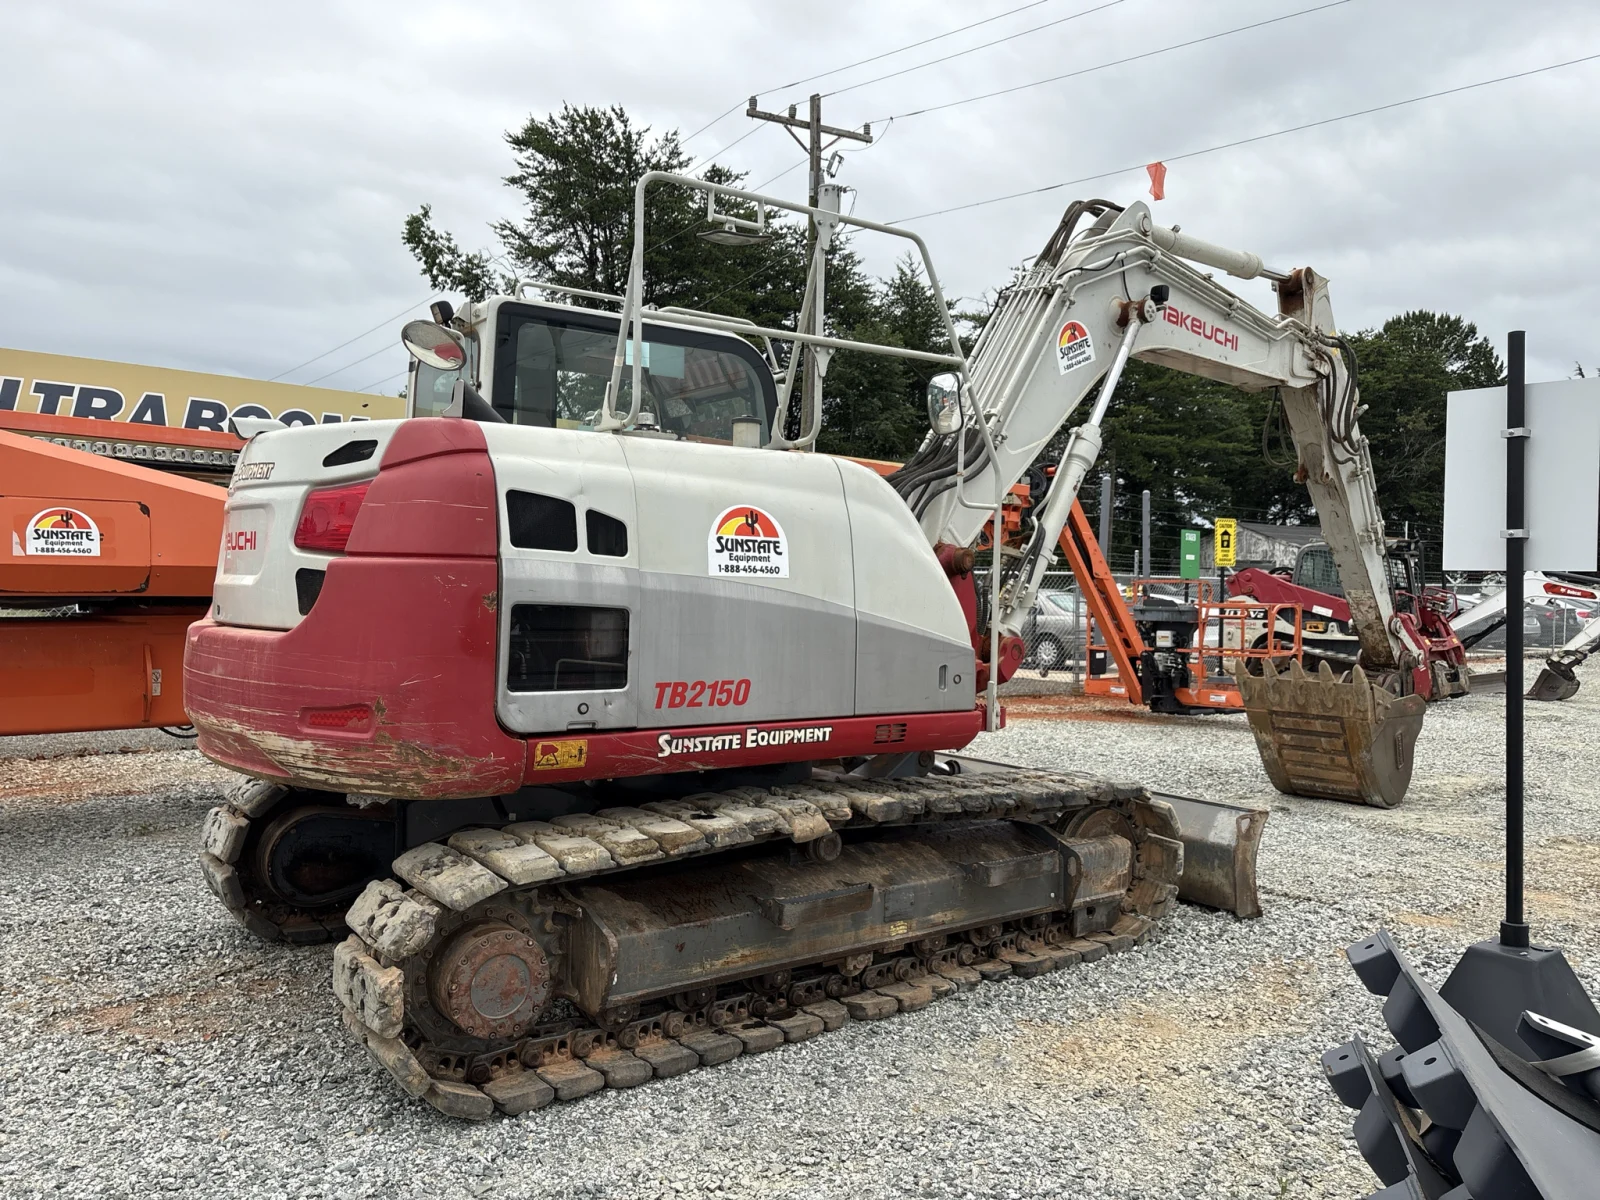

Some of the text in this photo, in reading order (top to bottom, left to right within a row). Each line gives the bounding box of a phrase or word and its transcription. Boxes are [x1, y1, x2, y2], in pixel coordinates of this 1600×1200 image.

[1060, 338, 1091, 360] SUNSTATE
[33, 528, 95, 542] SUNSTATE
[44, 539, 83, 547] Equipment
[715, 535, 783, 556] SUNSTATE
[728, 552, 771, 563] Equipment
[718, 564, 780, 575] 1-888-456-4560
[654, 679, 752, 710] TB2150
[657, 726, 833, 758] SUNSTATE EQUIPMENT
